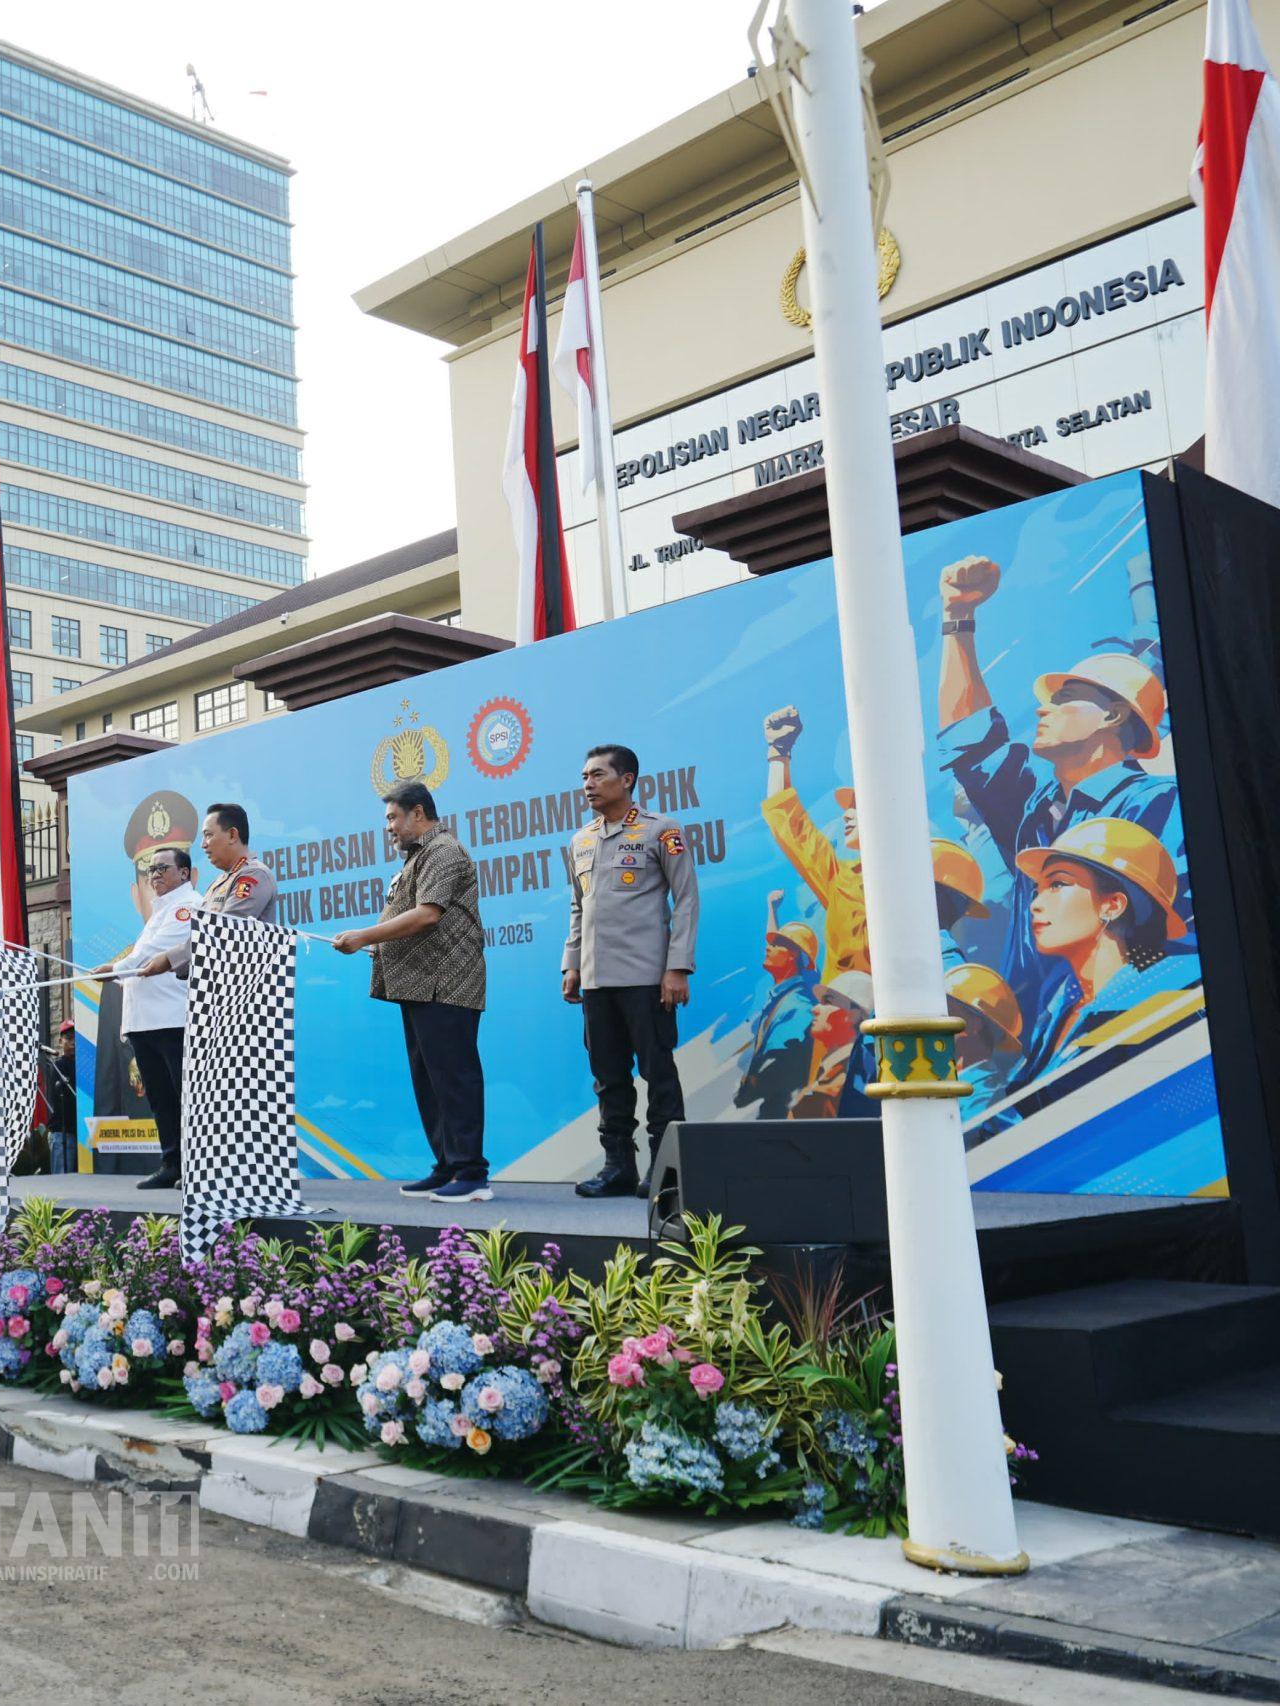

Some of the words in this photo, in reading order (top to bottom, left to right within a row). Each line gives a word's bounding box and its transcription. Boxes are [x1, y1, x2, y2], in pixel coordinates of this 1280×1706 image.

[616, 426, 729, 489] EPOLISIAN
[737, 392, 820, 444] NEGAR
[884, 327, 992, 392] PUBLIK
[1001, 258, 1185, 349] INDONESIA
[628, 553, 651, 571] JL.
[1055, 390, 1152, 437] SELATAN
[753, 443, 825, 488] MARK
[890, 398, 961, 440] ESAR
[489, 731, 510, 744] SPSI
[262, 830, 376, 882] PELEPASAN
[465, 787, 590, 848] TERDAMP
[638, 766, 700, 815] PHK
[618, 843, 645, 852] POLRI
[273, 888, 314, 927] TUK
[318, 877, 388, 922] BEKER
[477, 848, 552, 898] MPAT
[498, 922, 534, 946] 2025
